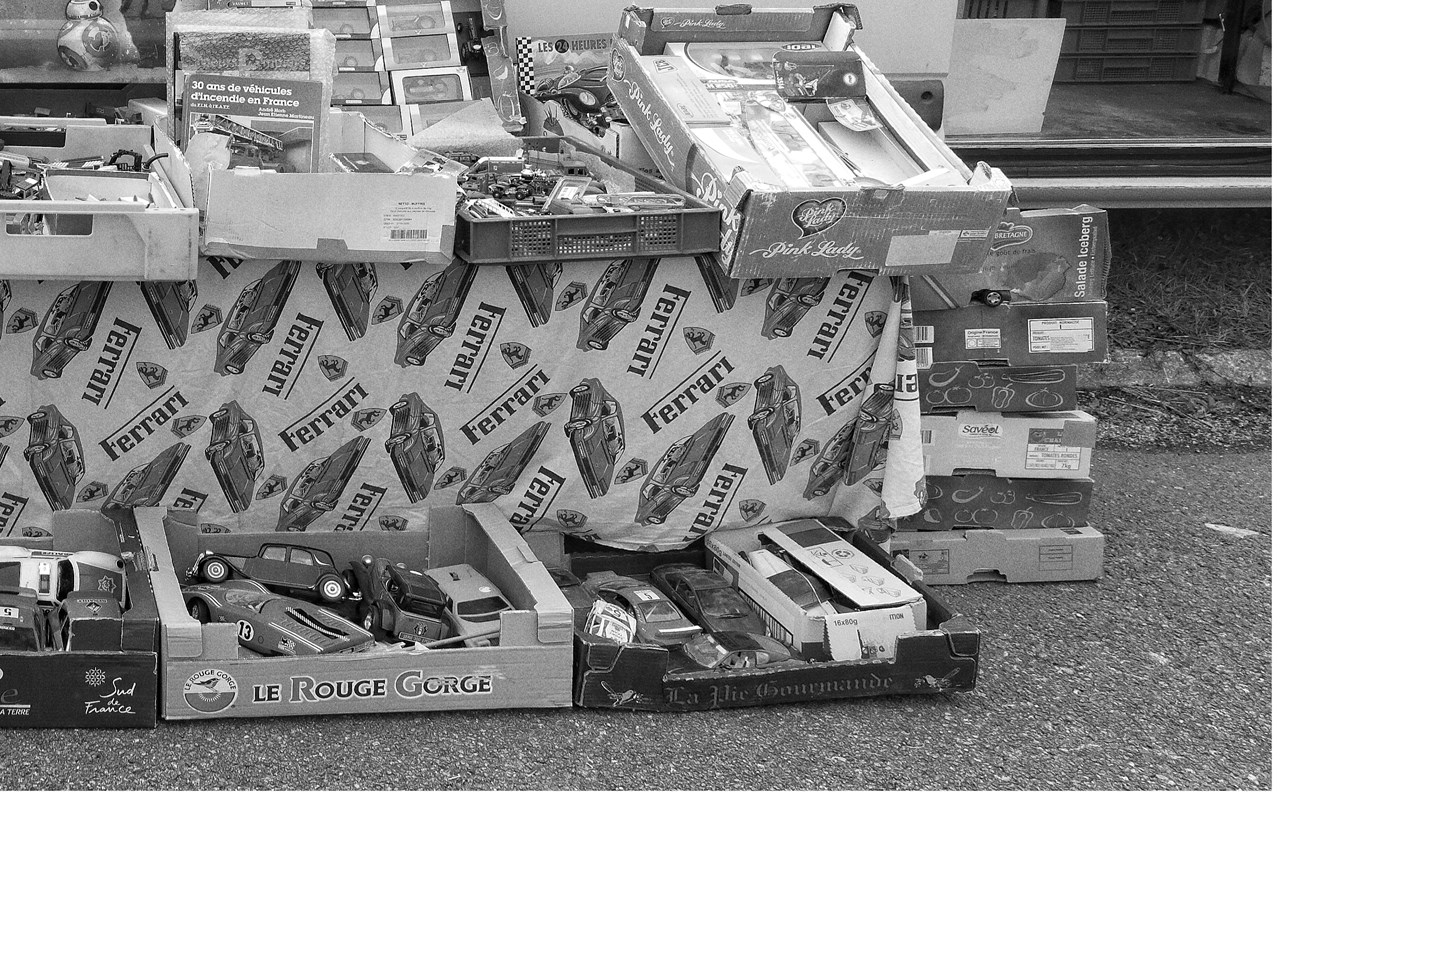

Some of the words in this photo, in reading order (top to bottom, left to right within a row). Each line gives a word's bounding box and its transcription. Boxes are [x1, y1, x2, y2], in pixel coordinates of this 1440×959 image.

[538, 42, 554, 53] LES
[571, 39, 607, 51] HEURES
[191, 81, 205, 89] 30
[206, 83, 226, 91] ans
[227, 82, 241, 92] de
[242, 83, 292, 96] véhicules
[191, 91, 246, 104] d'incendie
[247, 97, 261, 105] en
[262, 96, 300, 108] France
[623, 79, 652, 121] Pink
[650, 112, 676, 171] Lady
[749, 240, 813, 259] Pink
[811, 240, 864, 260] Lady
[994, 230, 1028, 239] BRETAGNE
[1077, 215, 1094, 259] Iceberg
[1074, 260, 1088, 298] Salade
[626, 283, 692, 379] Ferrari
[807, 271, 875, 361] Ferrari
[262, 311, 324, 400] Ferrari
[444, 300, 507, 392] Ferrari
[81, 317, 142, 409] Ferrari
[459, 365, 552, 445] Ferrari
[640, 353, 735, 434] Ferrari
[816, 366, 872, 416] Ferr
[98, 387, 190, 461] Ferrari
[277, 381, 370, 452] Ferrari
[962, 424, 1000, 435] Savéol
[238, 622, 252, 641] 13
[834, 618, 858, 627] 16x80g
[99, 677, 137, 699] Sud
[184, 680, 192, 691] LE
[190, 669, 216, 683] ROUGE
[215, 670, 238, 691] GORGE
[253, 685, 280, 703] LE
[290, 676, 387, 702] ROUGE
[396, 670, 492, 700] GORGE
[666, 686, 700, 705] La
[757, 672, 893, 700] Gourmande
[7, 707, 31, 716] TERRE
[84, 700, 137, 715] France
[107, 697, 119, 707] de
